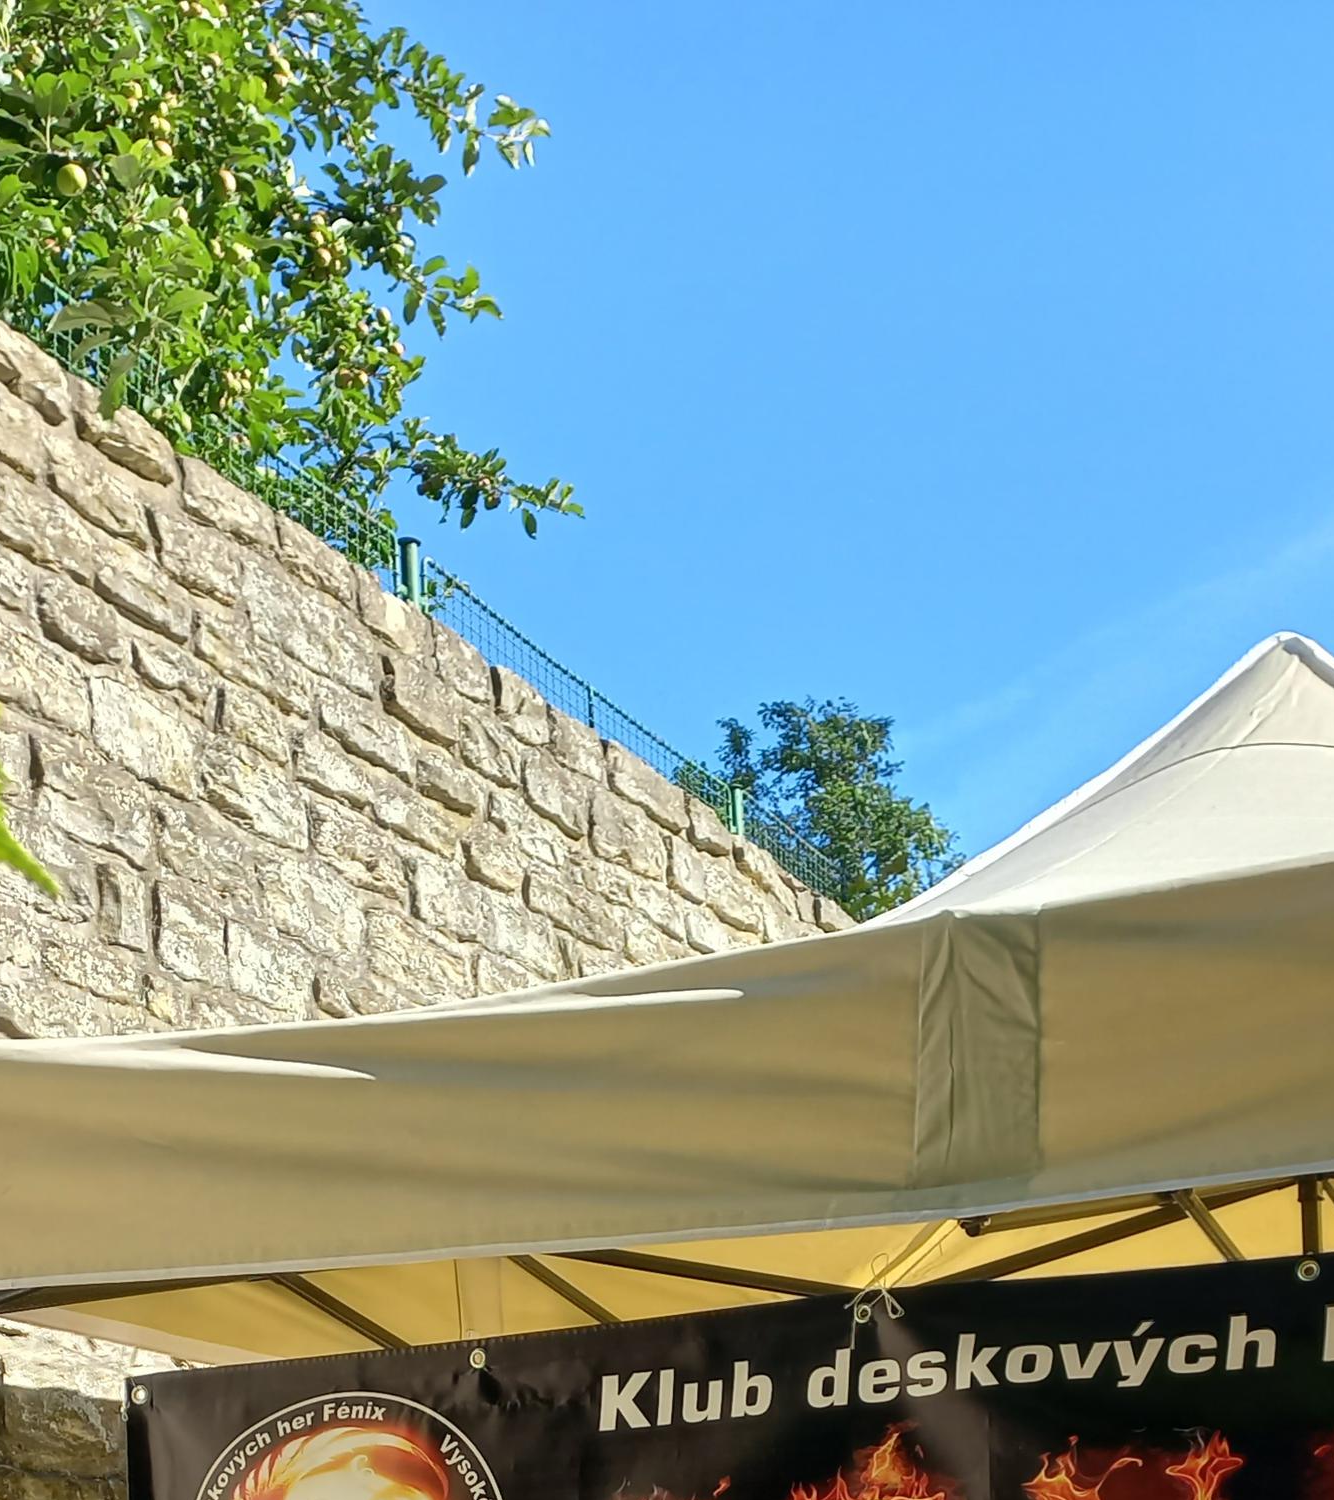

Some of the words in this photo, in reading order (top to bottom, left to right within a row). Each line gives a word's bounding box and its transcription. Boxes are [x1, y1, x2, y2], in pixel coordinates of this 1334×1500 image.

[598, 1361, 774, 1432] Klub
[806, 1315, 1278, 1409] deskových
[276, 1409, 316, 1438] her
[321, 1402, 387, 1423] Fénix
